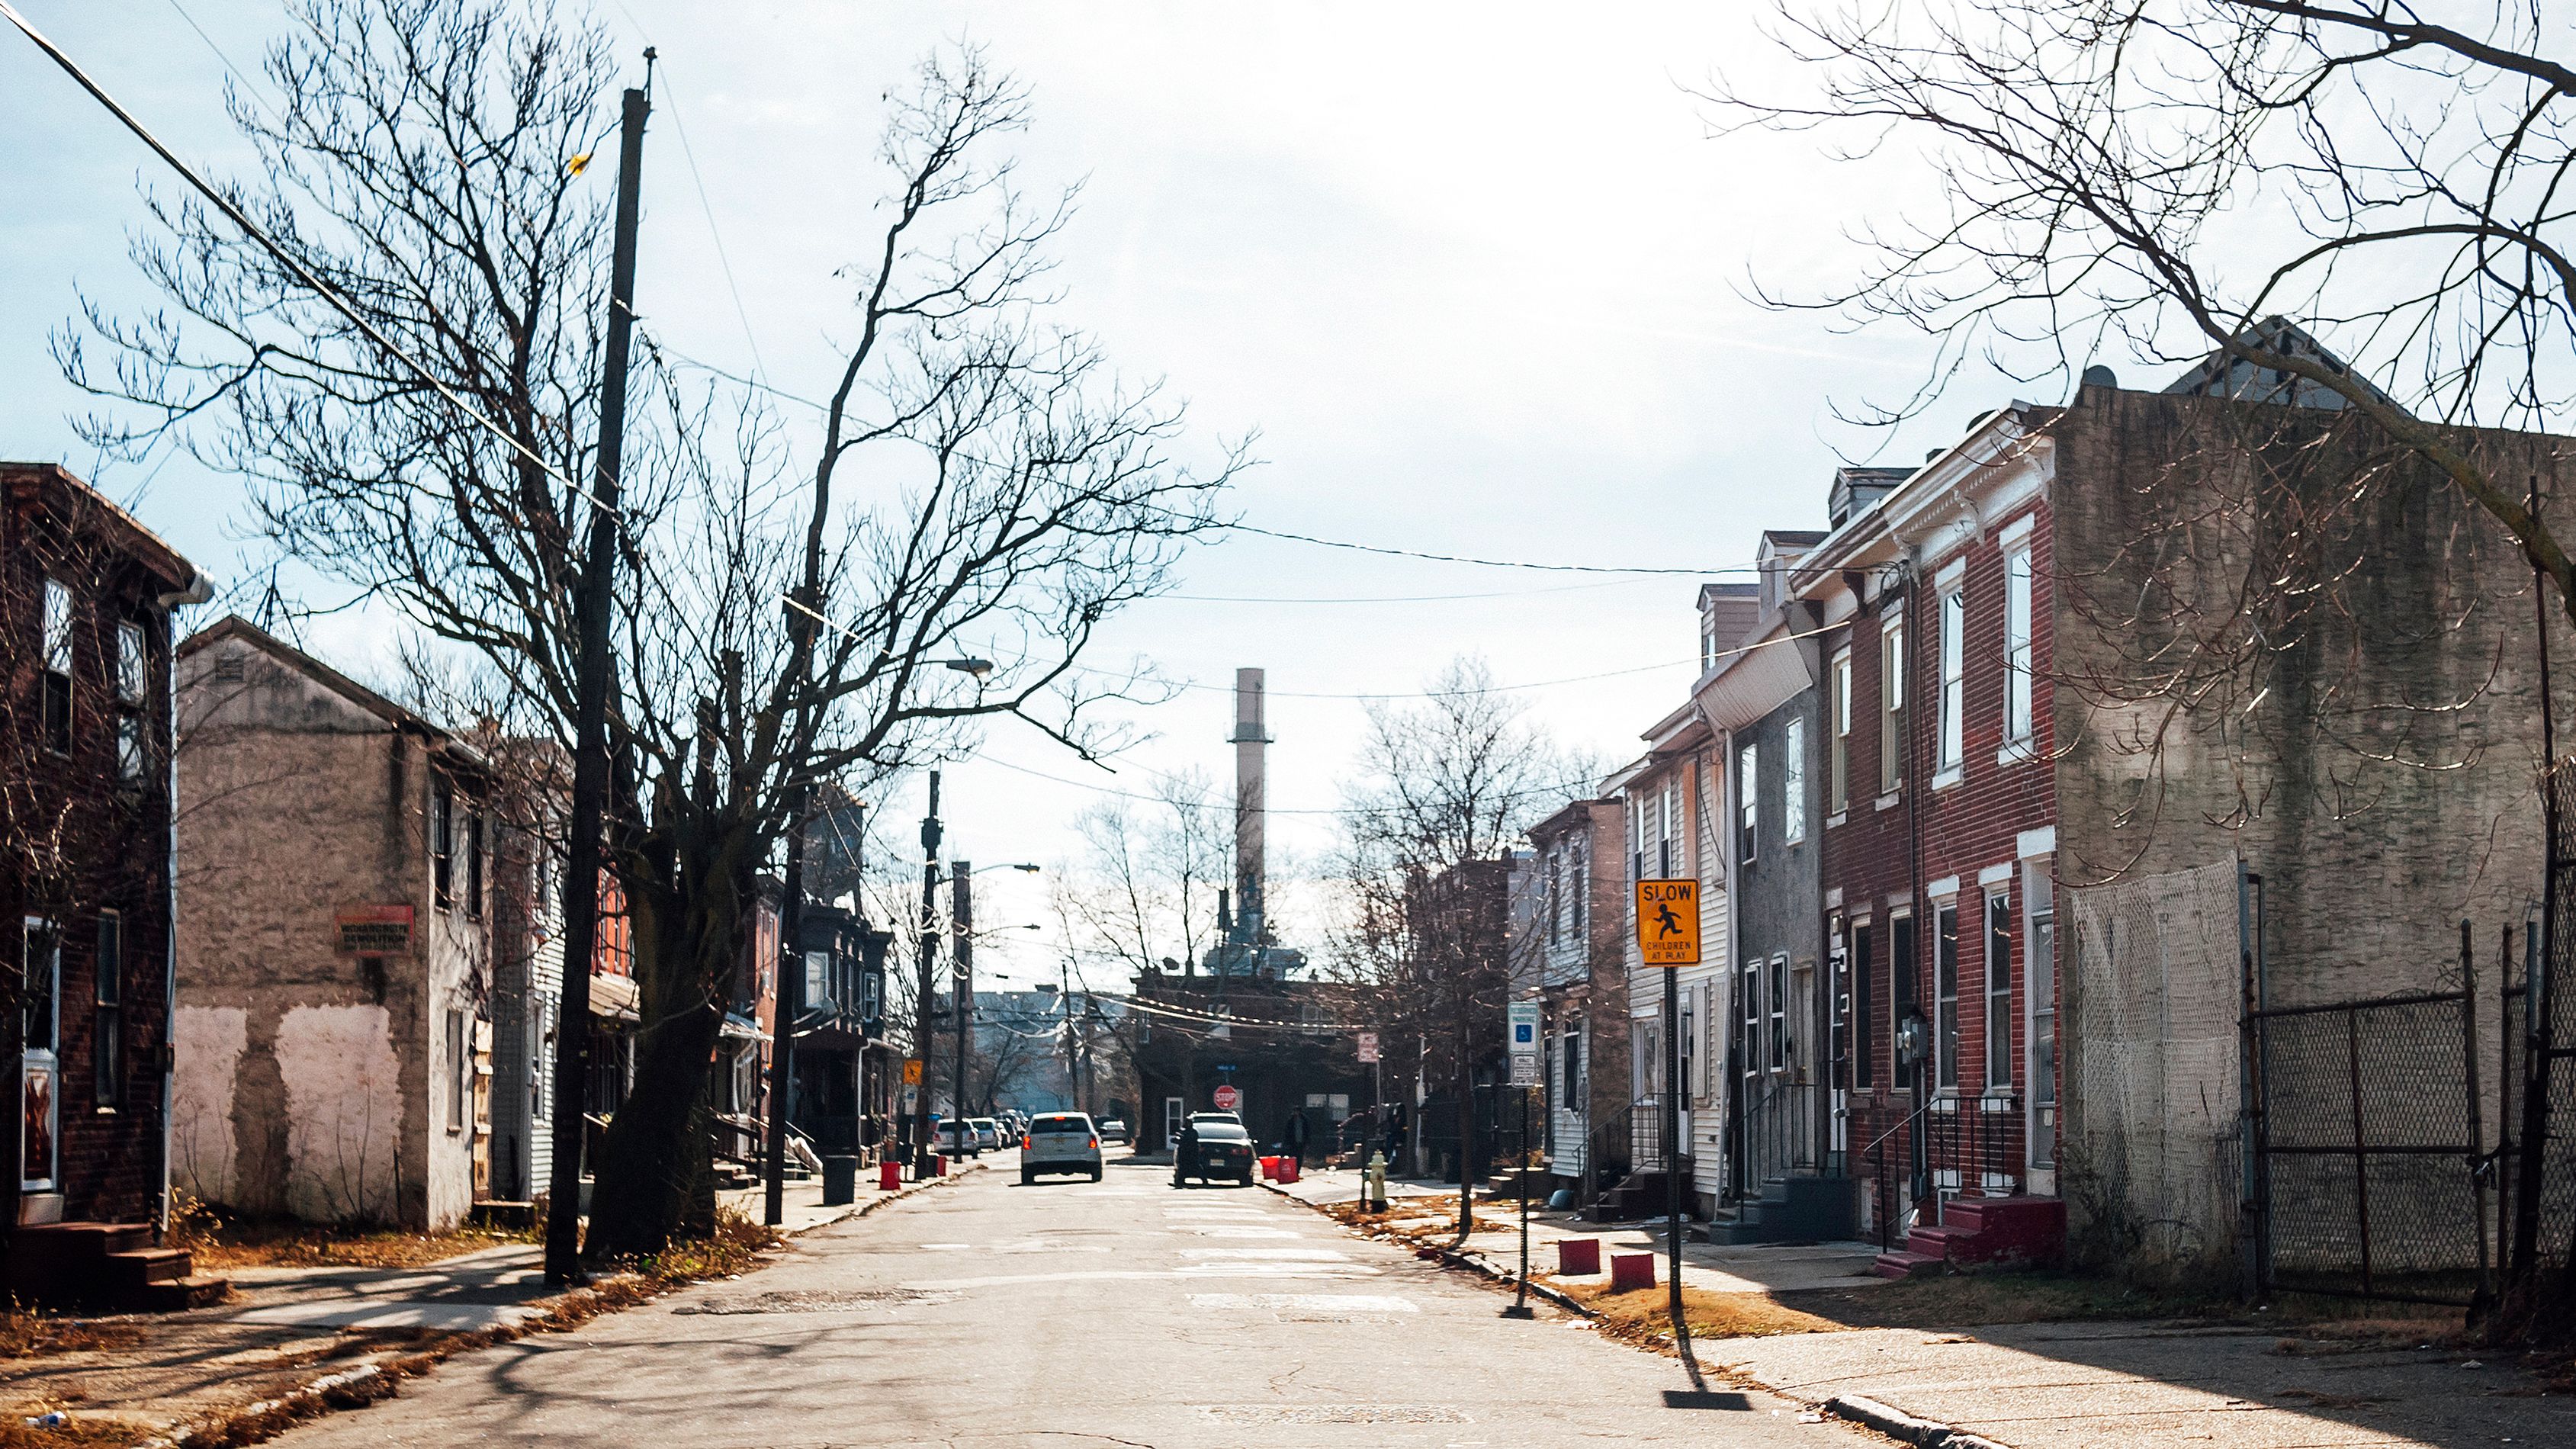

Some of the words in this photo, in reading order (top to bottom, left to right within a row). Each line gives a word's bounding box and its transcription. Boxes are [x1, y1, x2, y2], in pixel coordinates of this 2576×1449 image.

[1643, 885, 1691, 901] SLOW
[1646, 941, 1691, 950] CHILDREN
[1651, 952, 1661, 960] AT
[1665, 952, 1686, 960] PLAY
[1216, 1093, 1236, 1102] STOP
